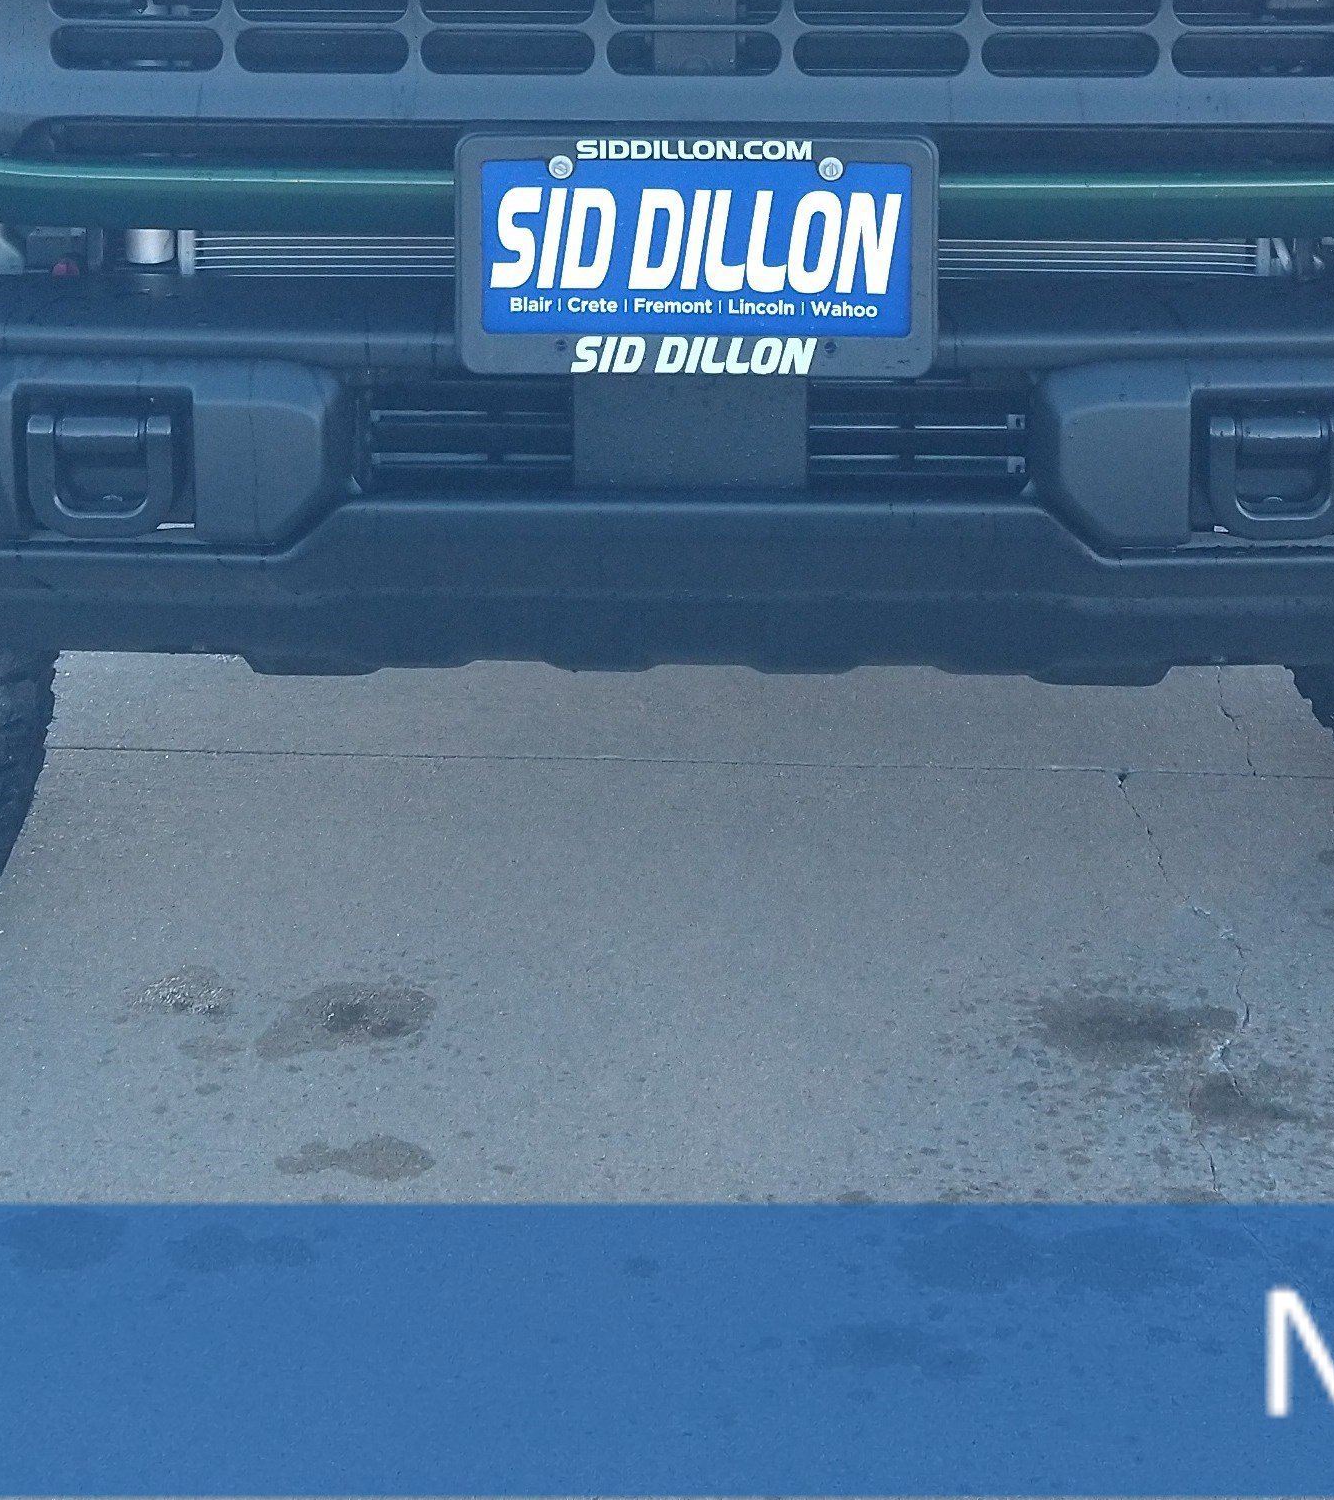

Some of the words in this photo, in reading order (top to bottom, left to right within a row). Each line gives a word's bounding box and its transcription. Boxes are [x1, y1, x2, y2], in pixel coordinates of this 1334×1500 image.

[576, 140, 813, 161] SIDDILLON.COM
[490, 187, 616, 289] SID
[628, 188, 902, 295] DILLON
[510, 296, 553, 312] Blair
[567, 297, 619, 313] Crete
[633, 297, 713, 314] Fremont
[728, 298, 795, 316] Lincoln
[810, 301, 879, 318] Wahoo
[571, 336, 645, 373] SID
[654, 337, 818, 375] DILLON
